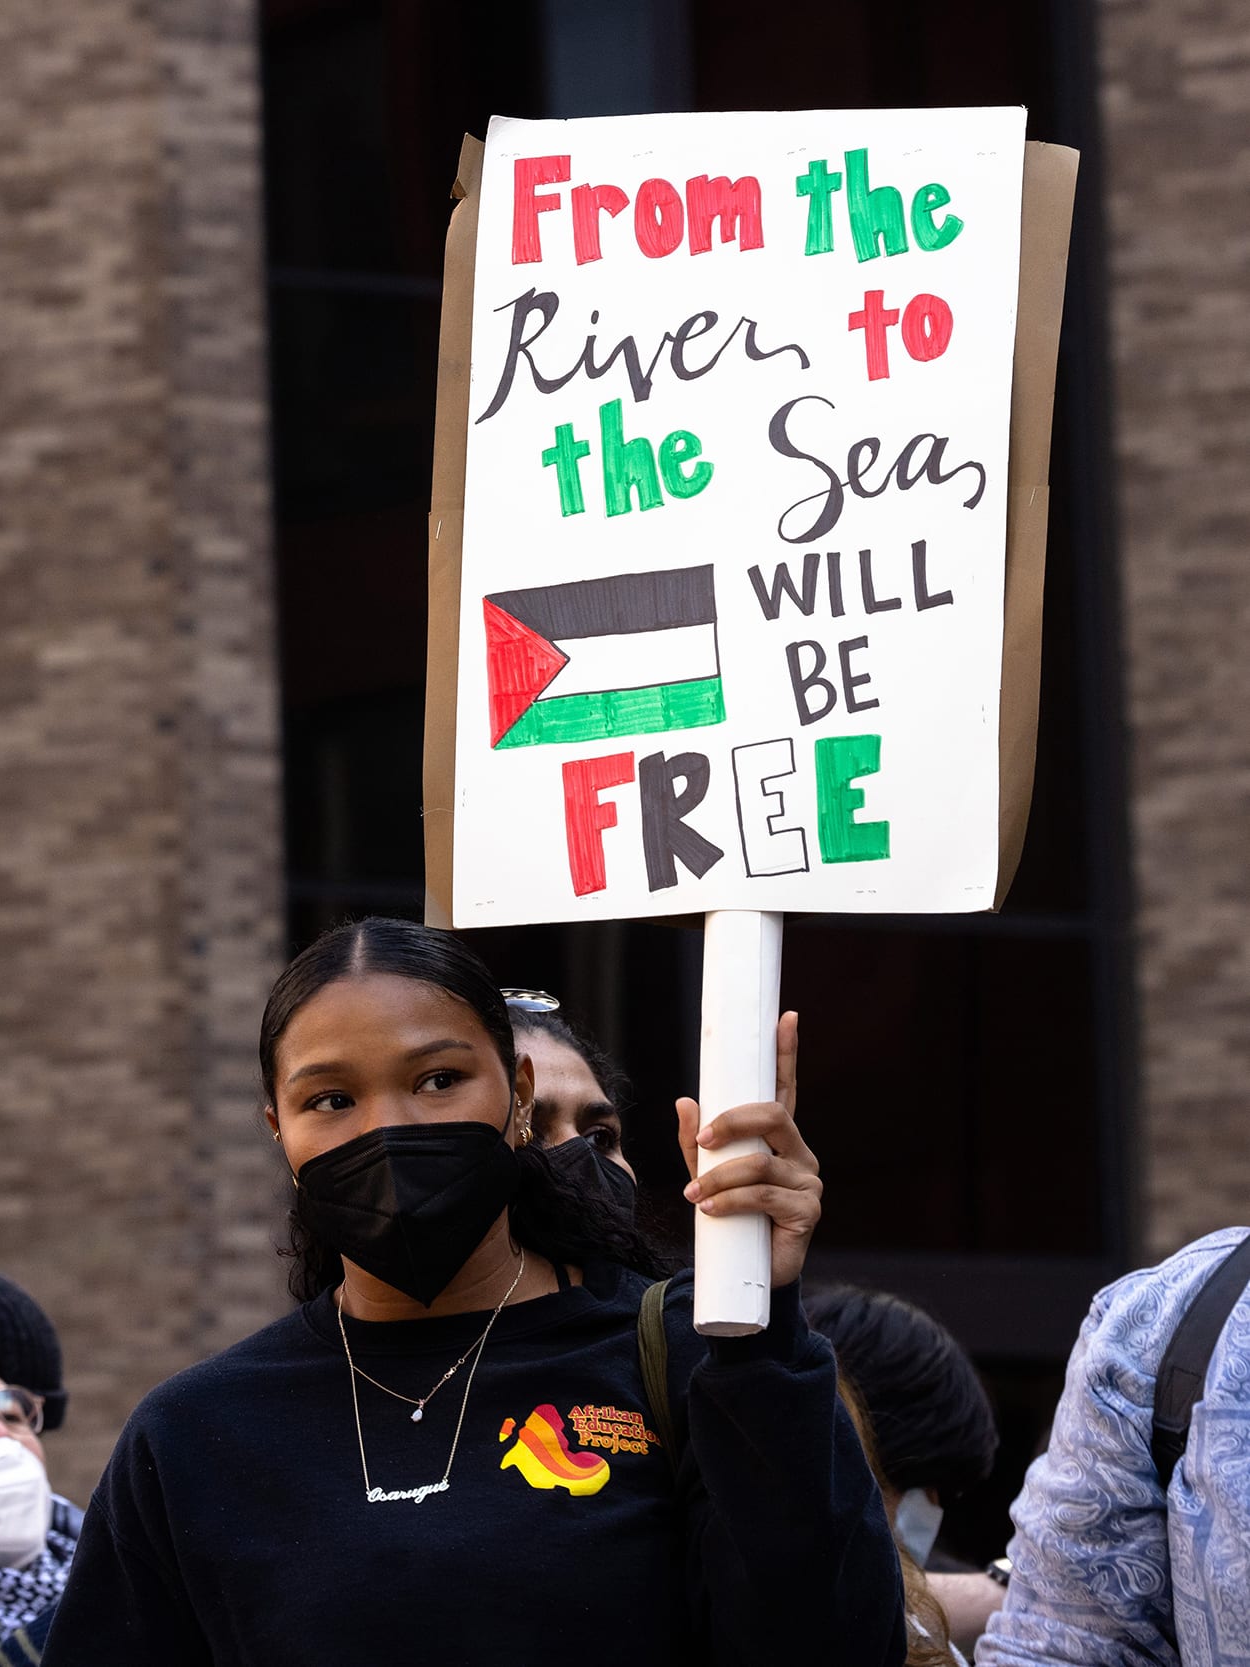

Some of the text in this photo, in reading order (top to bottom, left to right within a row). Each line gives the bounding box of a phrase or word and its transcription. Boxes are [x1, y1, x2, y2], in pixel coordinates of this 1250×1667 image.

[512, 148, 964, 266] From the
[475, 287, 953, 425] River to
[542, 395, 986, 543] the Sea
[747, 540, 953, 620] WILL
[785, 636, 880, 726] BE
[561, 734, 891, 897] FREE
[567, 1404, 644, 1424] Afrikan
[578, 1430, 649, 1455] Project
